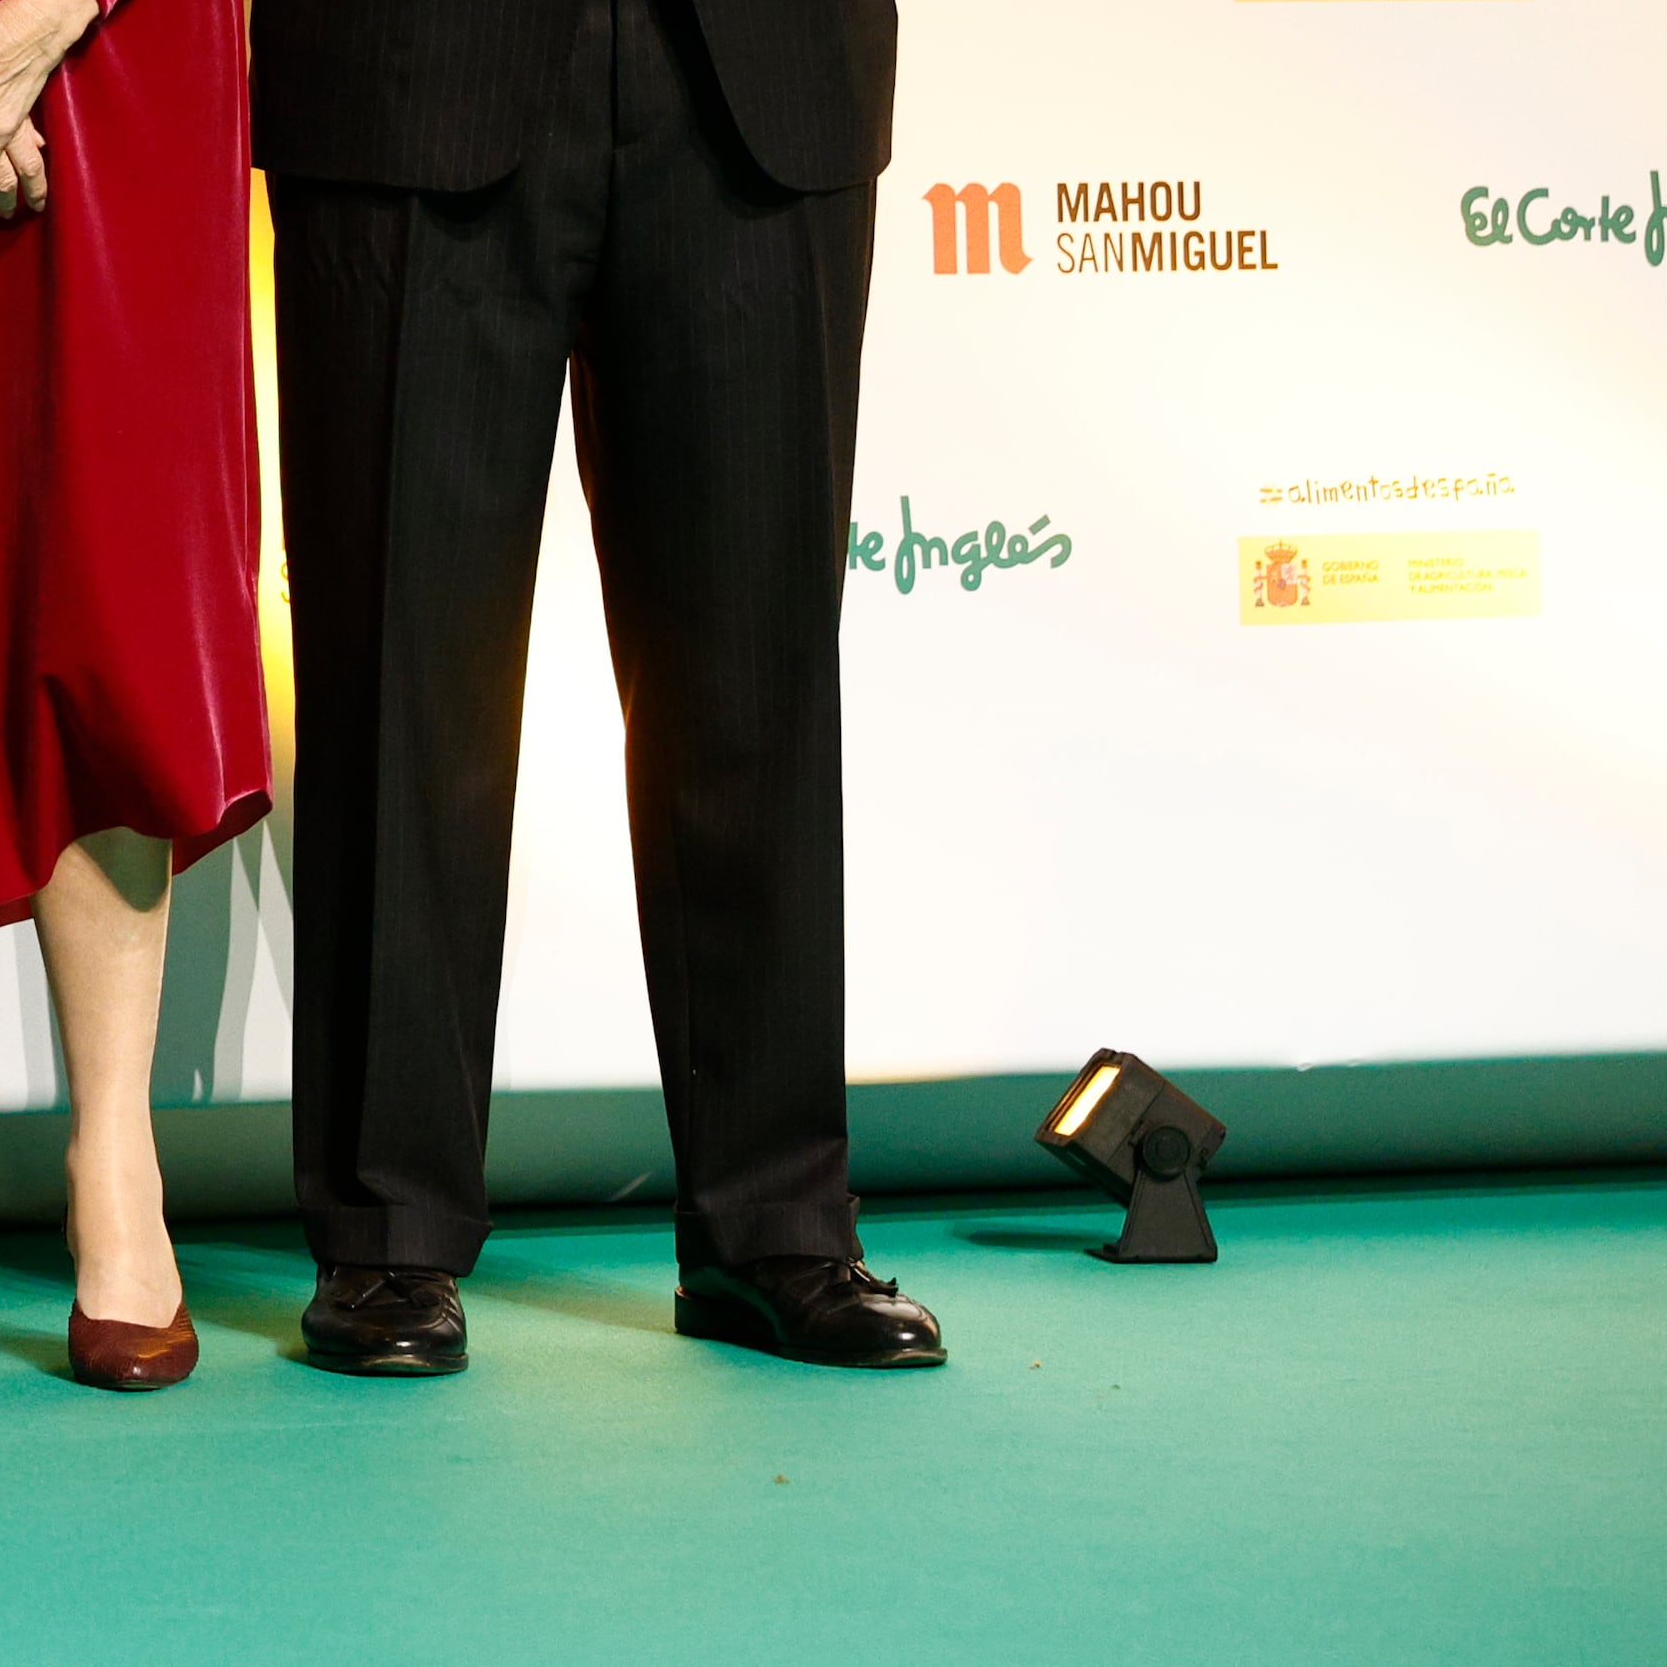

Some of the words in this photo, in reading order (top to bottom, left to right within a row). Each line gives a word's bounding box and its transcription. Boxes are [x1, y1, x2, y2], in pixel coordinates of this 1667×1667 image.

[1056, 181, 1201, 223] MAHOU
[1461, 186, 1513, 246] El
[1517, 188, 1636, 246] Corte
[1056, 229, 1278, 274] SANMIGUEL
[894, 495, 1072, 595] Inglés
